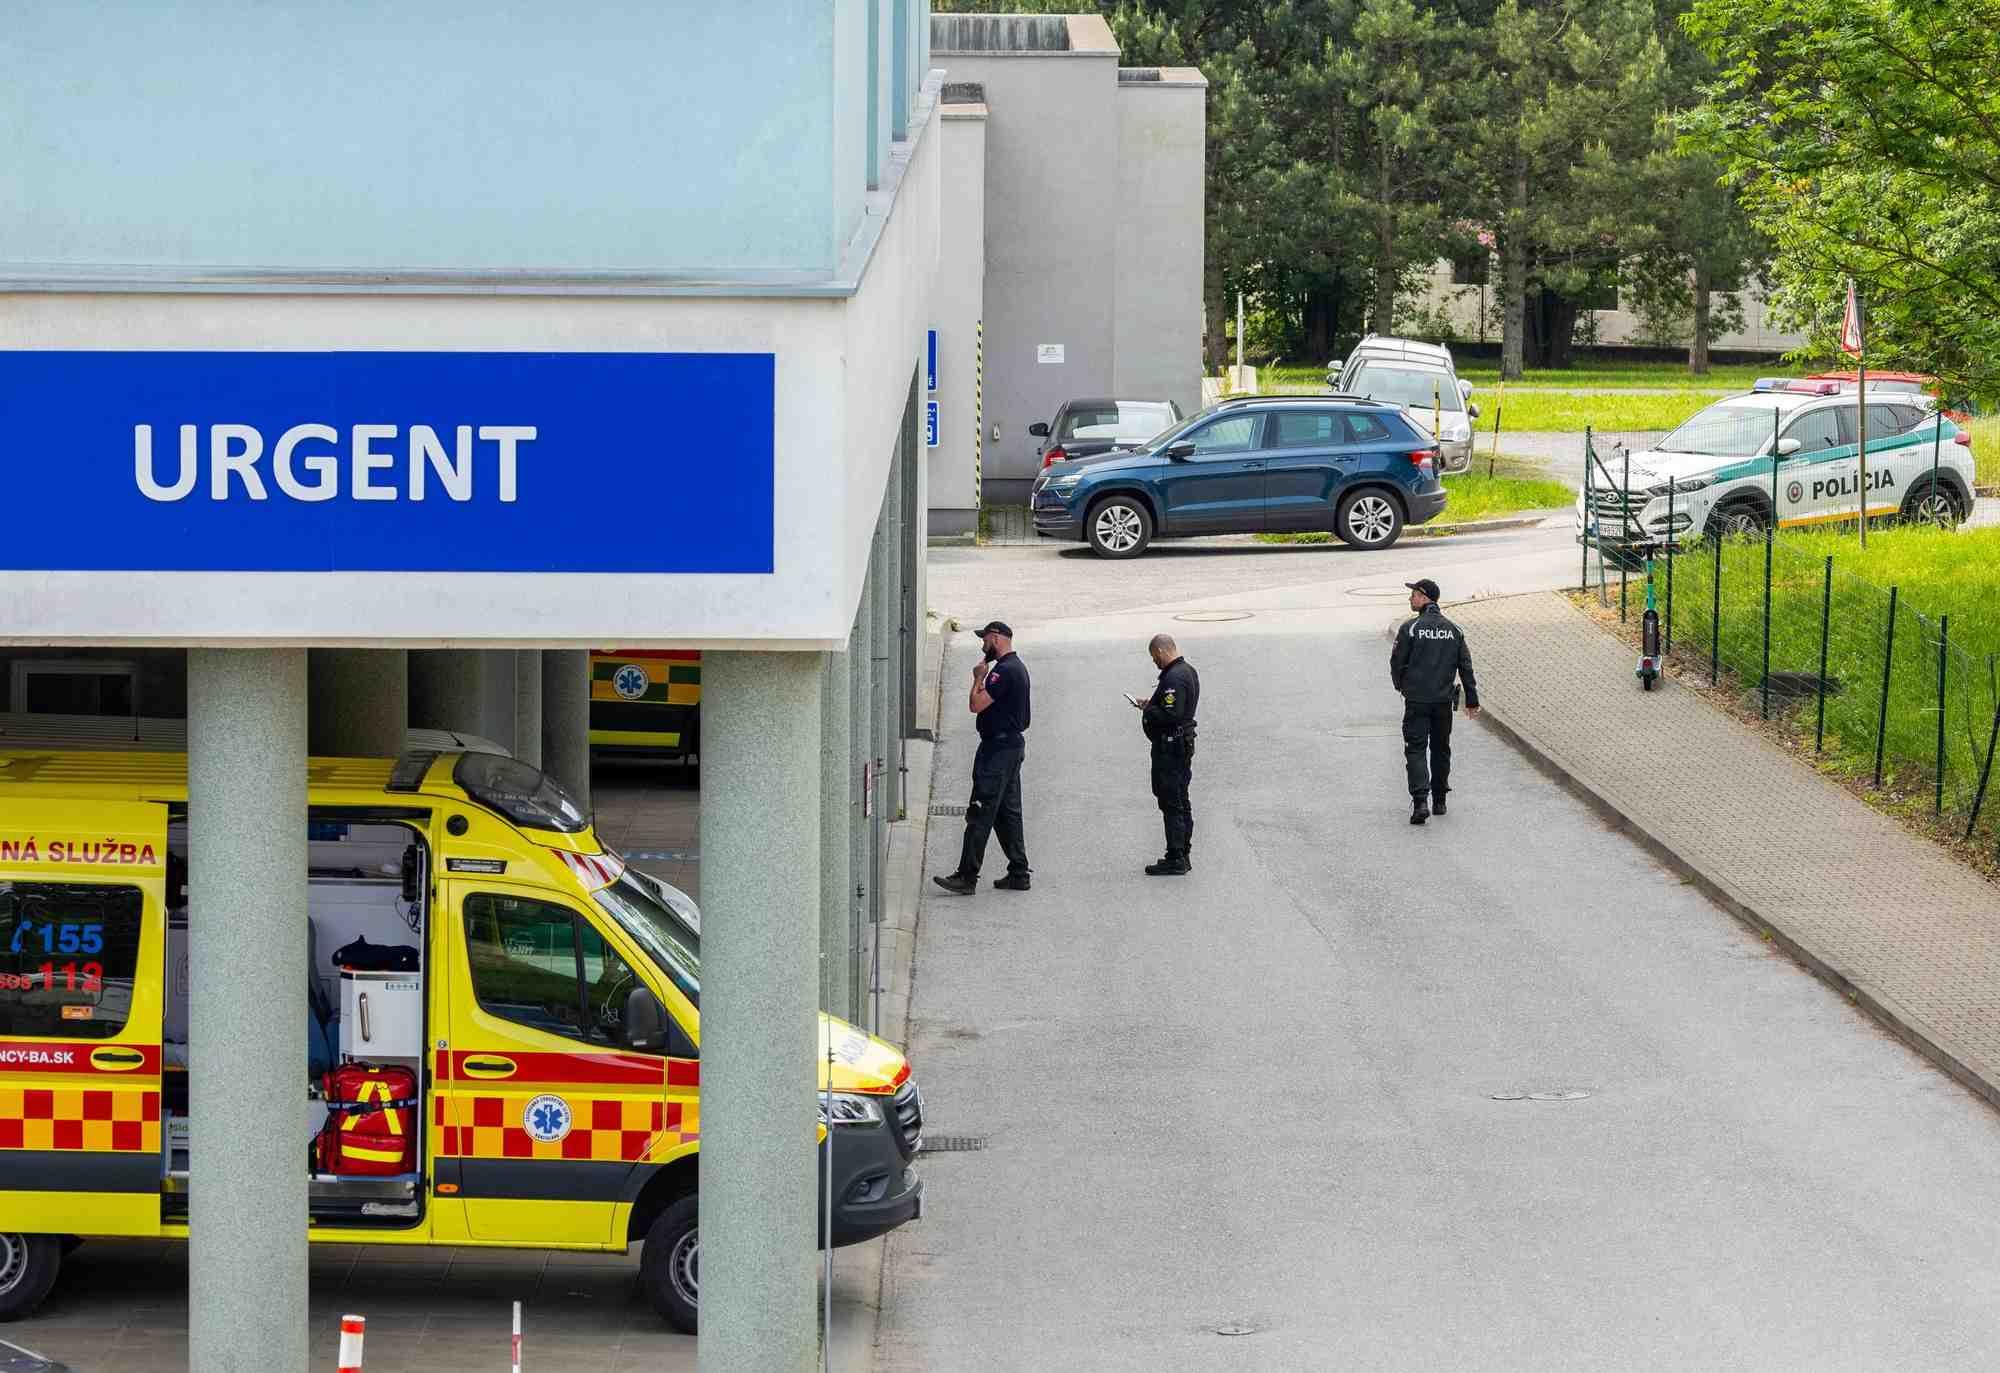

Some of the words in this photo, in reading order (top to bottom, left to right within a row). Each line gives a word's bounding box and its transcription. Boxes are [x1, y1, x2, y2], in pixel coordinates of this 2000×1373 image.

[134, 423, 538, 502] URGENT
[1812, 469, 1896, 500] POLÍCIA
[1418, 627, 1455, 640] POLÍCIA
[48, 838, 157, 865] SLUŽBA
[38, 924, 104, 954] 155
[39, 961, 104, 992] 112
